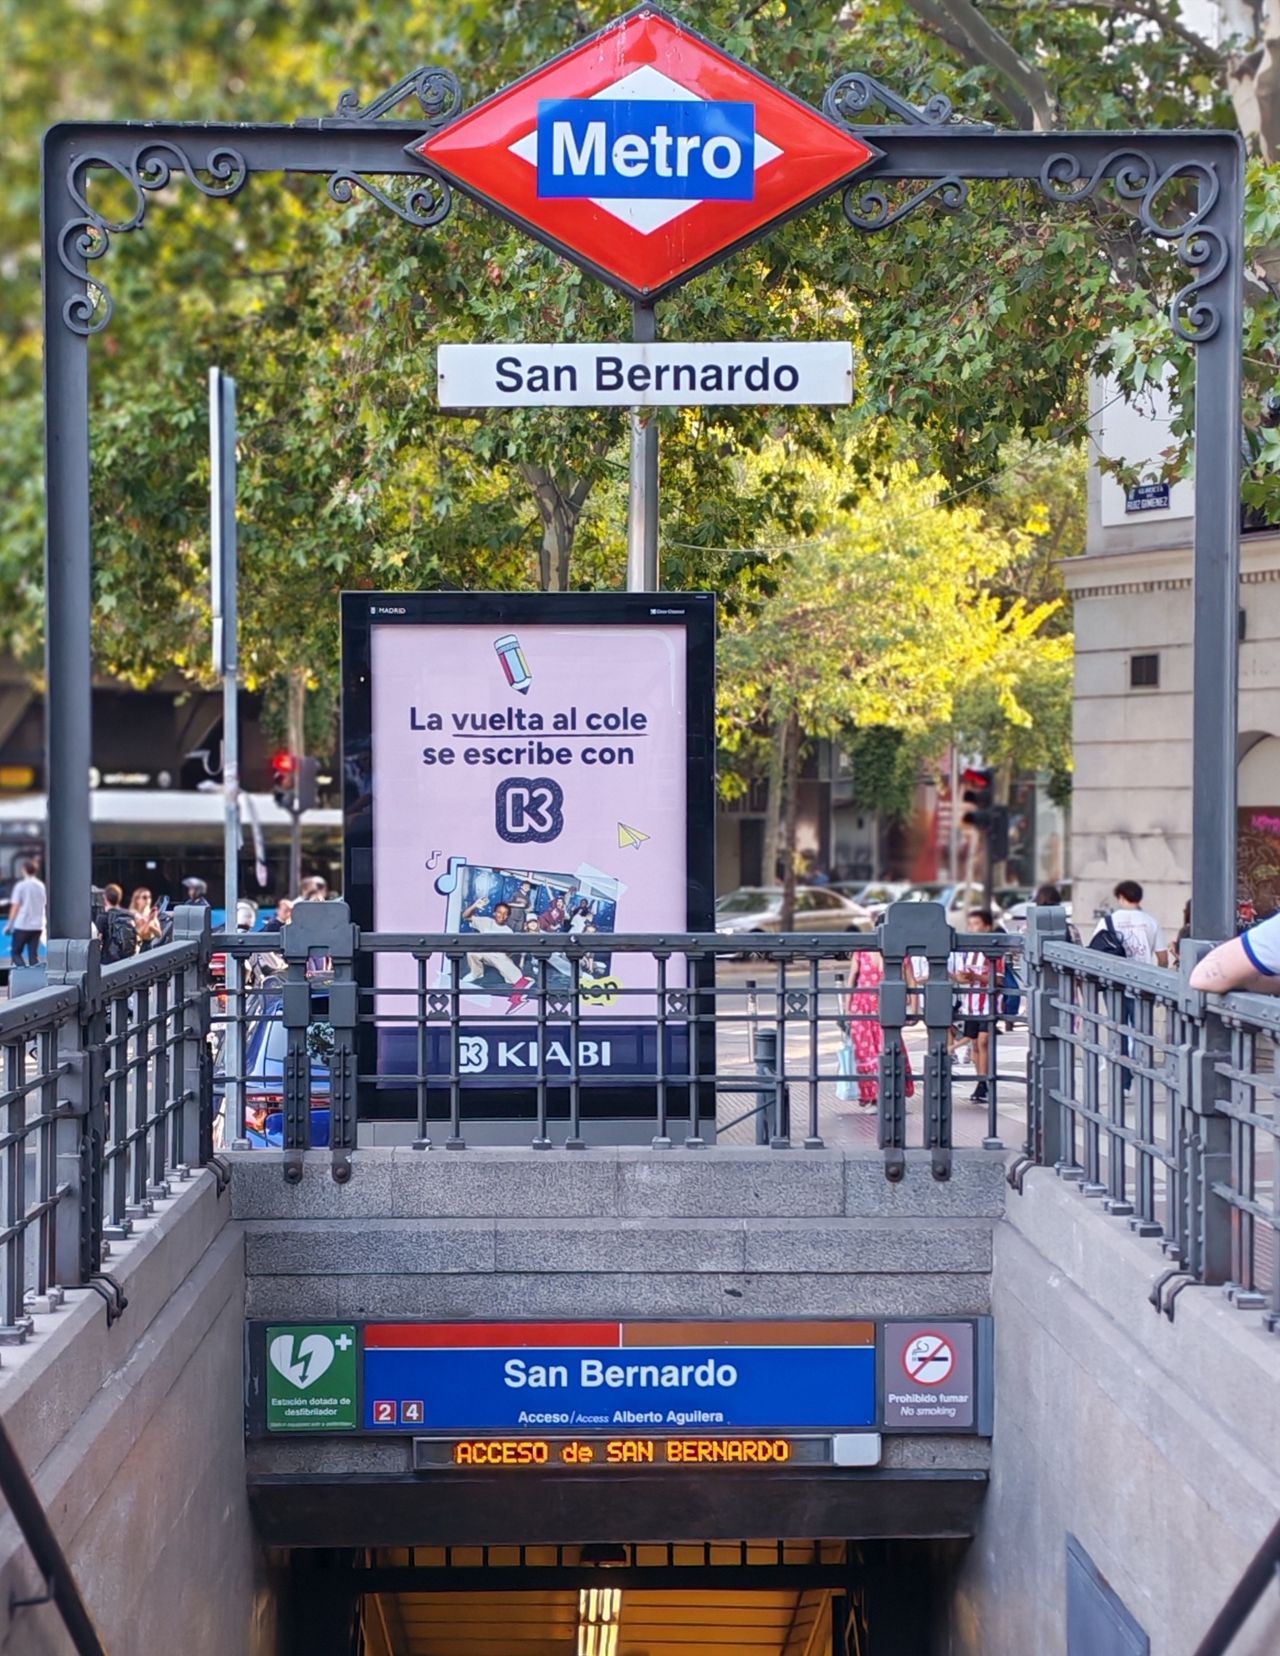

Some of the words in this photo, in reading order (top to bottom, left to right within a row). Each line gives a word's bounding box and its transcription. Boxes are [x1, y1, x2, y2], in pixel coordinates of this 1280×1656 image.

[552, 121, 742, 179] Metro
[495, 356, 577, 392] San
[596, 356, 799, 392] Bernardo
[379, 607, 407, 615] MADRID
[410, 706, 443, 731] La
[452, 706, 544, 731] vuelta
[553, 706, 577, 731] al
[586, 706, 648, 731] cole
[422, 746, 456, 766] se
[463, 740, 573, 766] escribe
[581, 746, 635, 766] con
[498, 1041, 611, 1067] KIABI
[504, 1358, 568, 1388] San
[580, 1358, 738, 1388] Bernardo
[271, 1397, 307, 1406] Estación
[309, 1397, 338, 1406] dotada
[340, 1397, 352, 1405] de
[888, 1393, 938, 1403] Prohibido
[939, 1393, 969, 1403] fumar
[284, 1407, 338, 1416] desfibrilador
[378, 1403, 392, 1421] 2
[405, 1403, 419, 1421] 4
[613, 1410, 663, 1423] Alberto
[666, 1410, 724, 1426] Aguilera
[900, 1406, 915, 1416] No
[916, 1406, 957, 1418] smoking
[457, 1442, 548, 1464] ACCESO
[562, 1442, 593, 1463] de
[606, 1441, 653, 1462] SAN
[667, 1440, 789, 1462] BERNARDO
